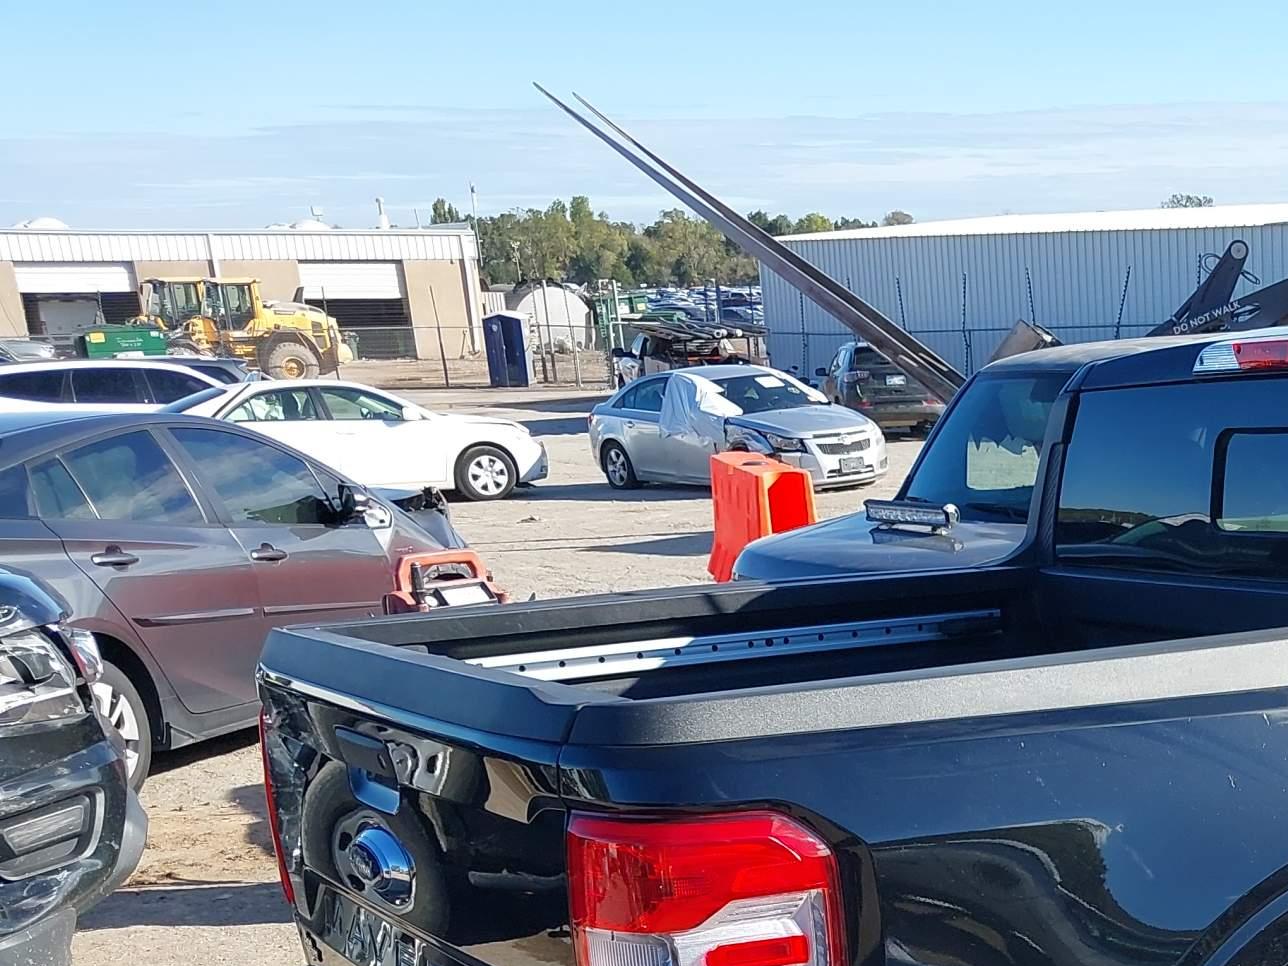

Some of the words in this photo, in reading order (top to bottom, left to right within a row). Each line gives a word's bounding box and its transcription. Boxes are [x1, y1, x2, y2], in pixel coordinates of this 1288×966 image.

[1173, 322, 1189, 335] DO
[1190, 312, 1212, 328] NOT
[1212, 300, 1242, 318] WALK
